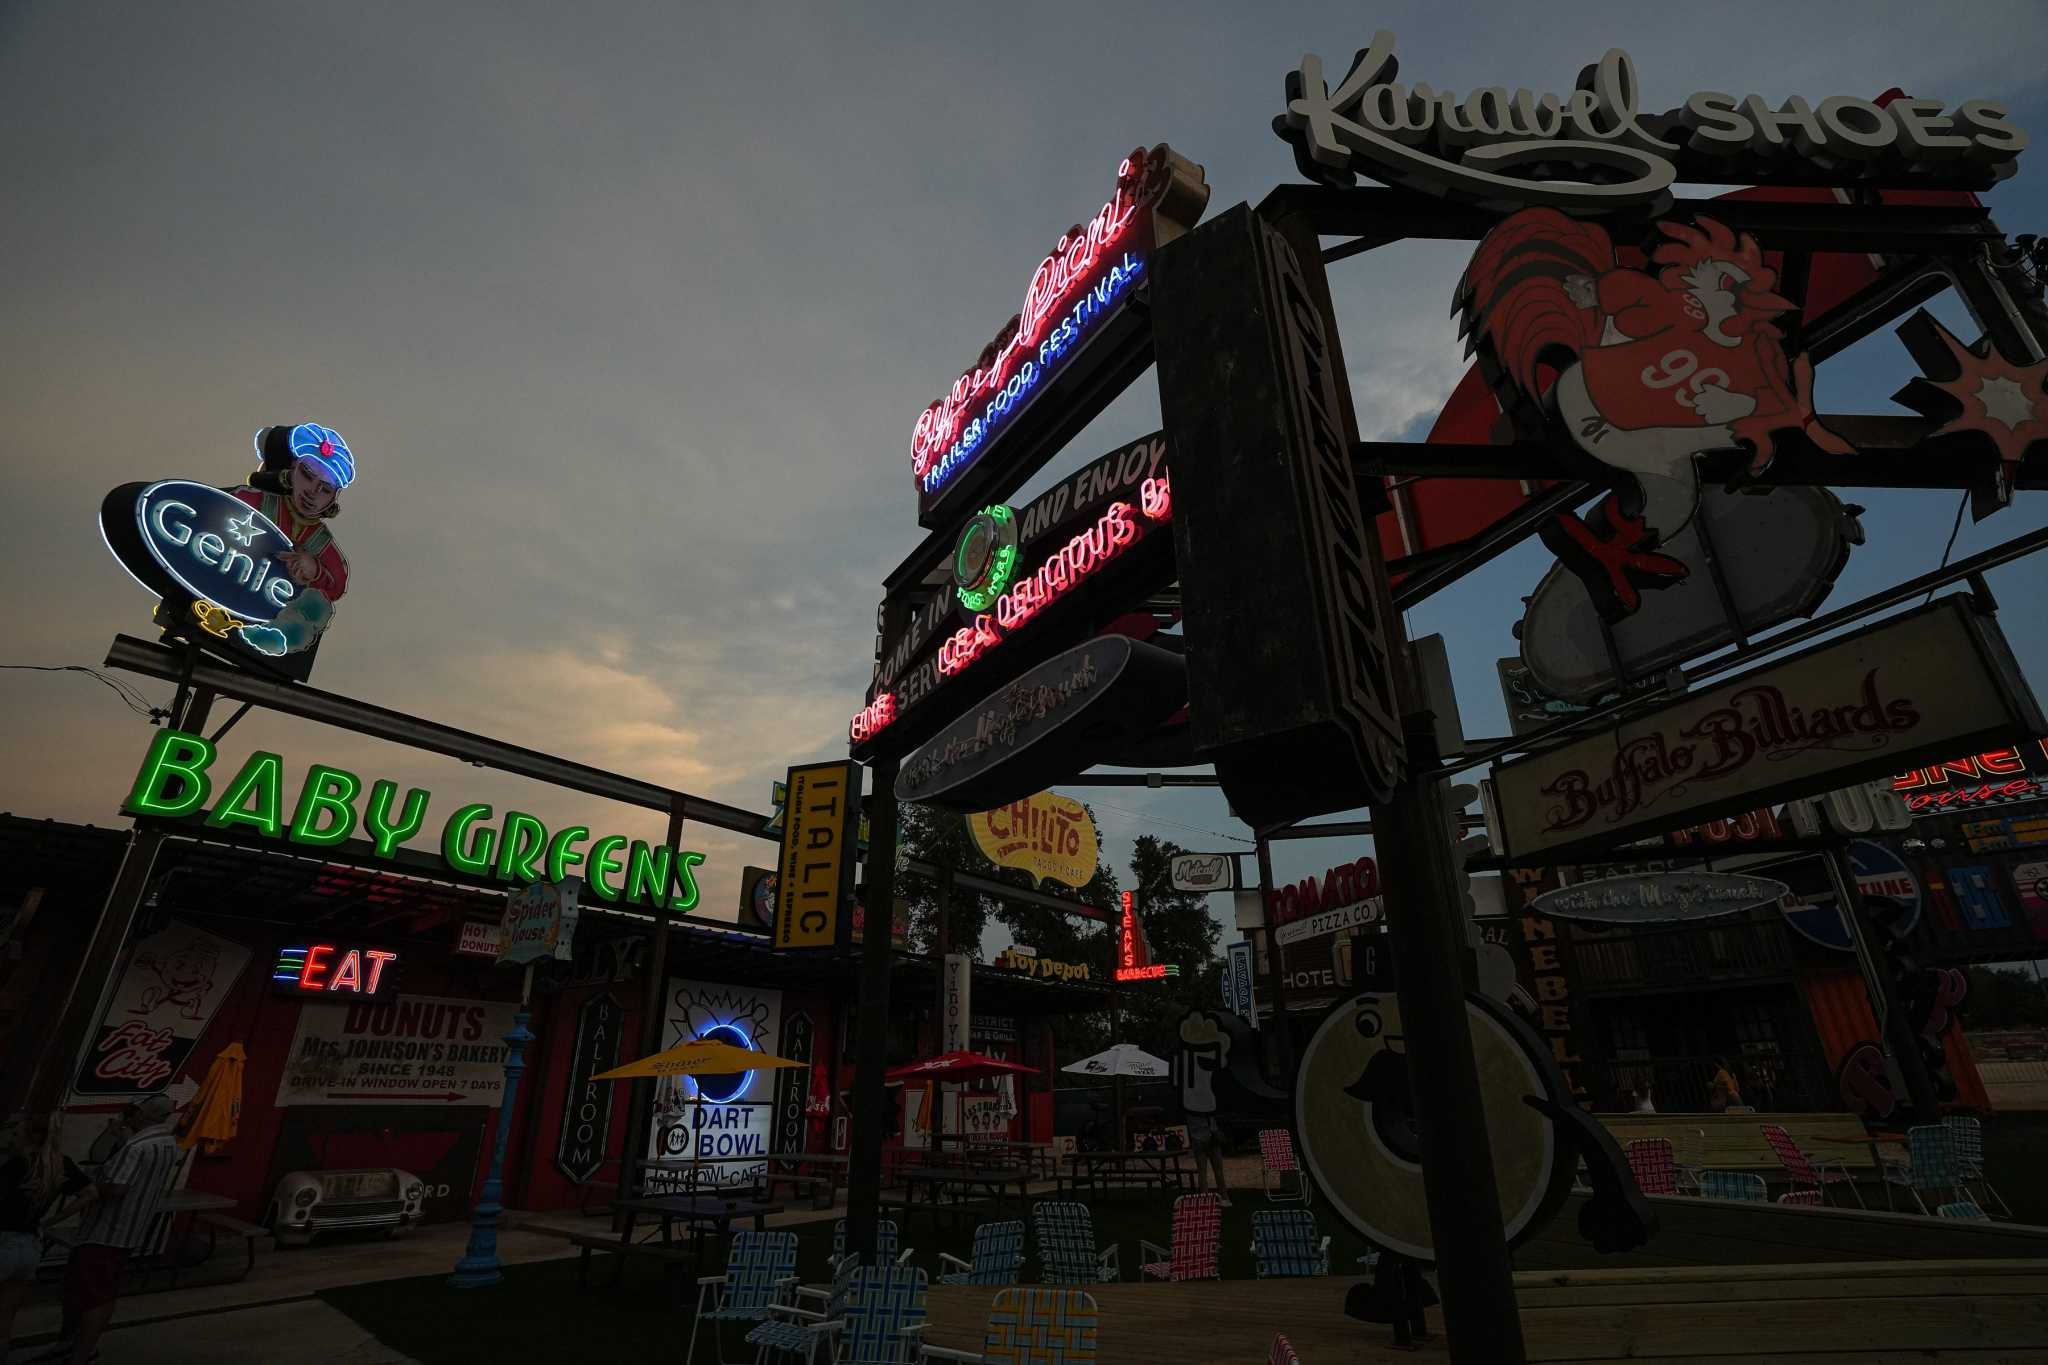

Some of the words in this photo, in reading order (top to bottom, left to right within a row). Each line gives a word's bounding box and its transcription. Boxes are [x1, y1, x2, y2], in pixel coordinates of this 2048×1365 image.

[1284, 29, 1680, 197] Karavel
[1686, 88, 2032, 156] SHOES
[921, 415, 983, 494] TRAILER
[986, 360, 1036, 422] FOOD
[1039, 251, 1140, 366] FESTIVAL
[1020, 487, 1074, 544] AND
[1074, 440, 1168, 512] ENJOY
[152, 499, 295, 608] Genie
[996, 499, 1143, 632] DELICIOUS
[1540, 730, 1698, 836] Buffalo
[1680, 665, 1921, 776] Billiards
[1903, 777, 2041, 813] ouse
[122, 727, 432, 860] BABY
[440, 803, 707, 913] GREENS
[799, 780, 839, 934] ITALIC
[1269, 856, 1378, 924] TOMATO
[463, 925, 489, 939] HOT
[507, 901, 559, 924] Spider
[1120, 890, 1134, 967] STEAKS
[1311, 910, 1351, 935] PIZZA
[299, 944, 397, 994] EAT
[1007, 949, 1038, 977] Toy
[1040, 957, 1090, 982] Depot
[98, 1019, 175, 1054] Fat
[343, 1001, 486, 1042] DONUTS
[95, 1049, 174, 1089] City
[346, 1039, 444, 1063] JOHNSON'S
[449, 1041, 511, 1064] BAKERY
[358, 1062, 411, 1077] SINCE
[417, 1063, 456, 1078] 1948
[289, 1076, 357, 1089] DRIVE-IN
[360, 1077, 419, 1089] WINDOW
[421, 1078, 457, 1090] OPEN
[459, 1079, 467, 1090] 7
[469, 1079, 501, 1091] DAYS
[691, 1107, 755, 1131] DART
[699, 1133, 767, 1157] BOWL
